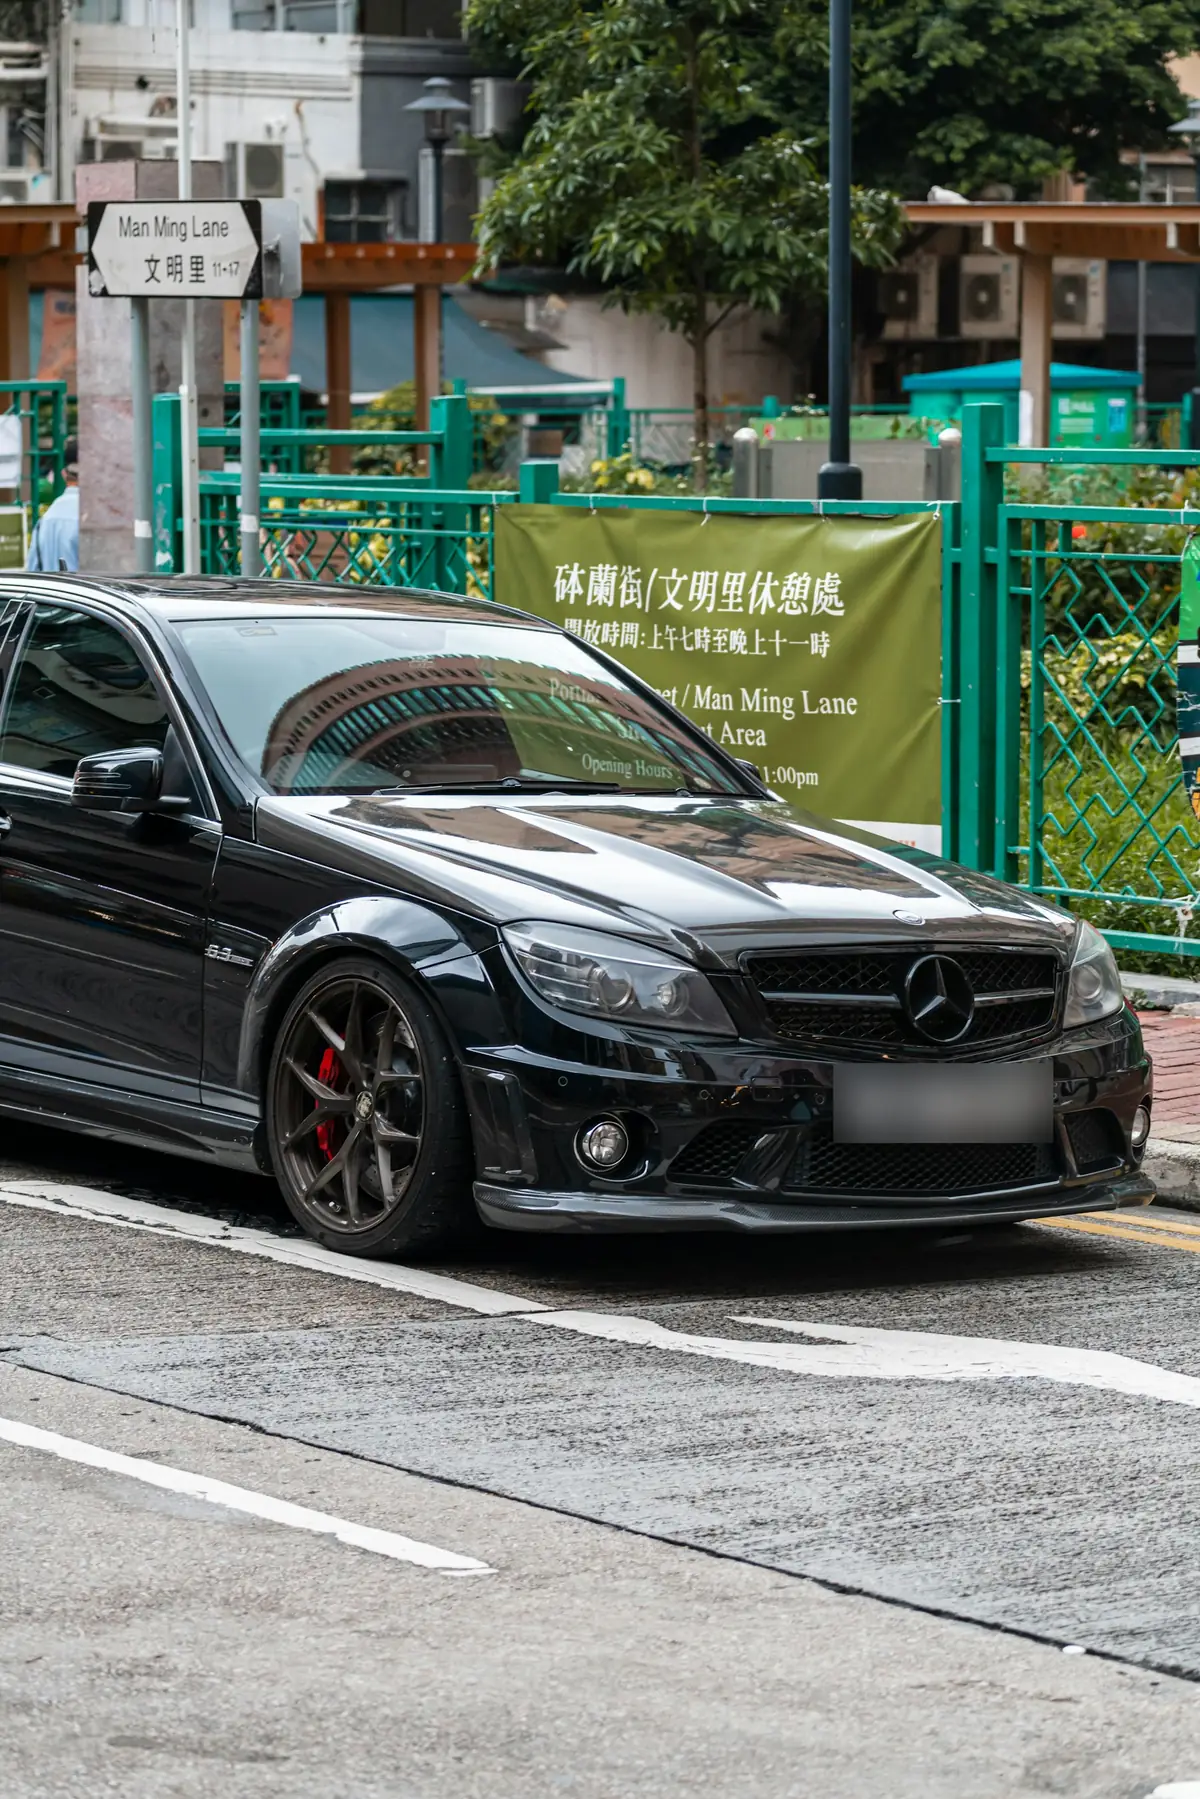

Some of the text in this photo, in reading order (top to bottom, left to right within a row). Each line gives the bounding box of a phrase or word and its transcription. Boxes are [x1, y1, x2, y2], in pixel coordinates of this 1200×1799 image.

[118, 215, 229, 242] Man Ming Lane
[144, 254, 206, 284] 文明里
[692, 684, 734, 711] Man
[741, 688, 796, 719] Ming
[801, 690, 858, 715] Lane
[720, 720, 767, 746] Area
[582, 753, 633, 779] Opening
[635, 760, 674, 779] Hours
